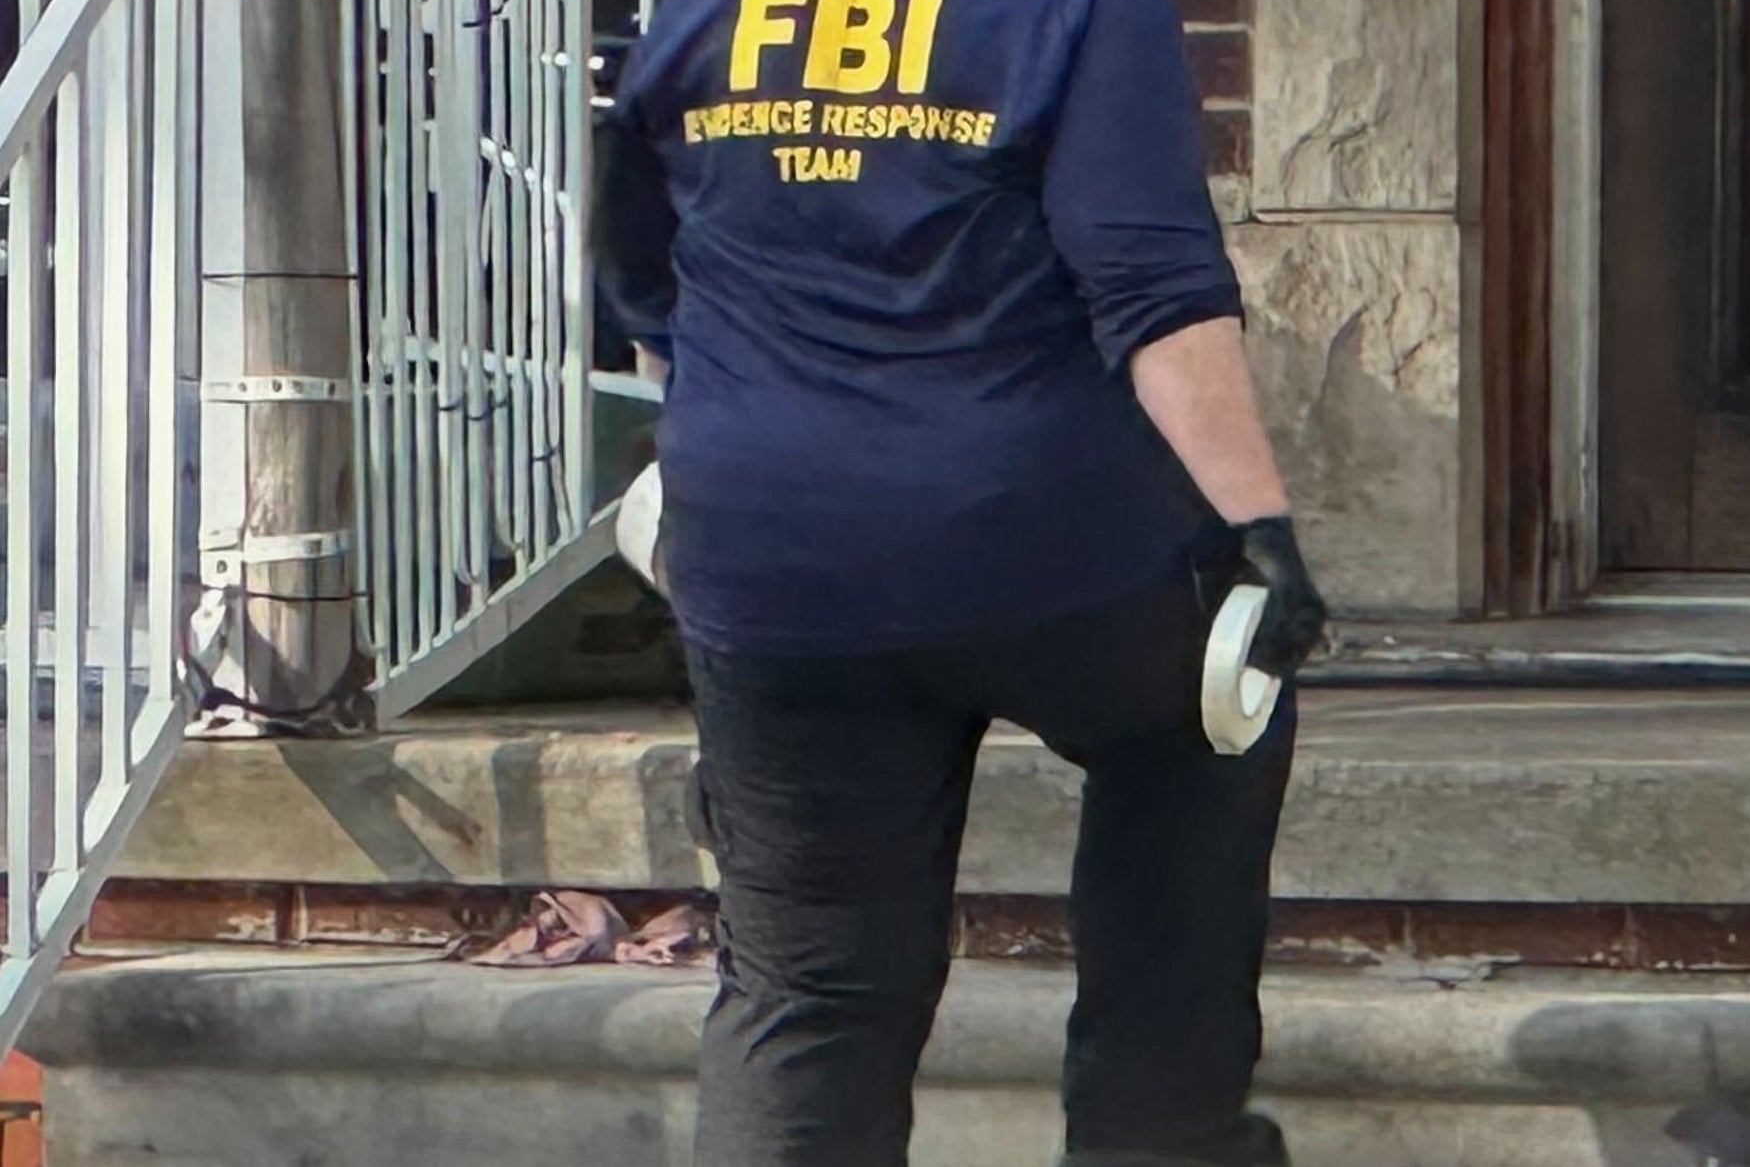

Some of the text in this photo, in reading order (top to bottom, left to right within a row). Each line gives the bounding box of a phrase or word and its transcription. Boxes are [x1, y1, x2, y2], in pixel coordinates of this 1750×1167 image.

[684, 99, 996, 147] EVDENCE RESPONSE
[772, 146, 862, 183] TEAM
